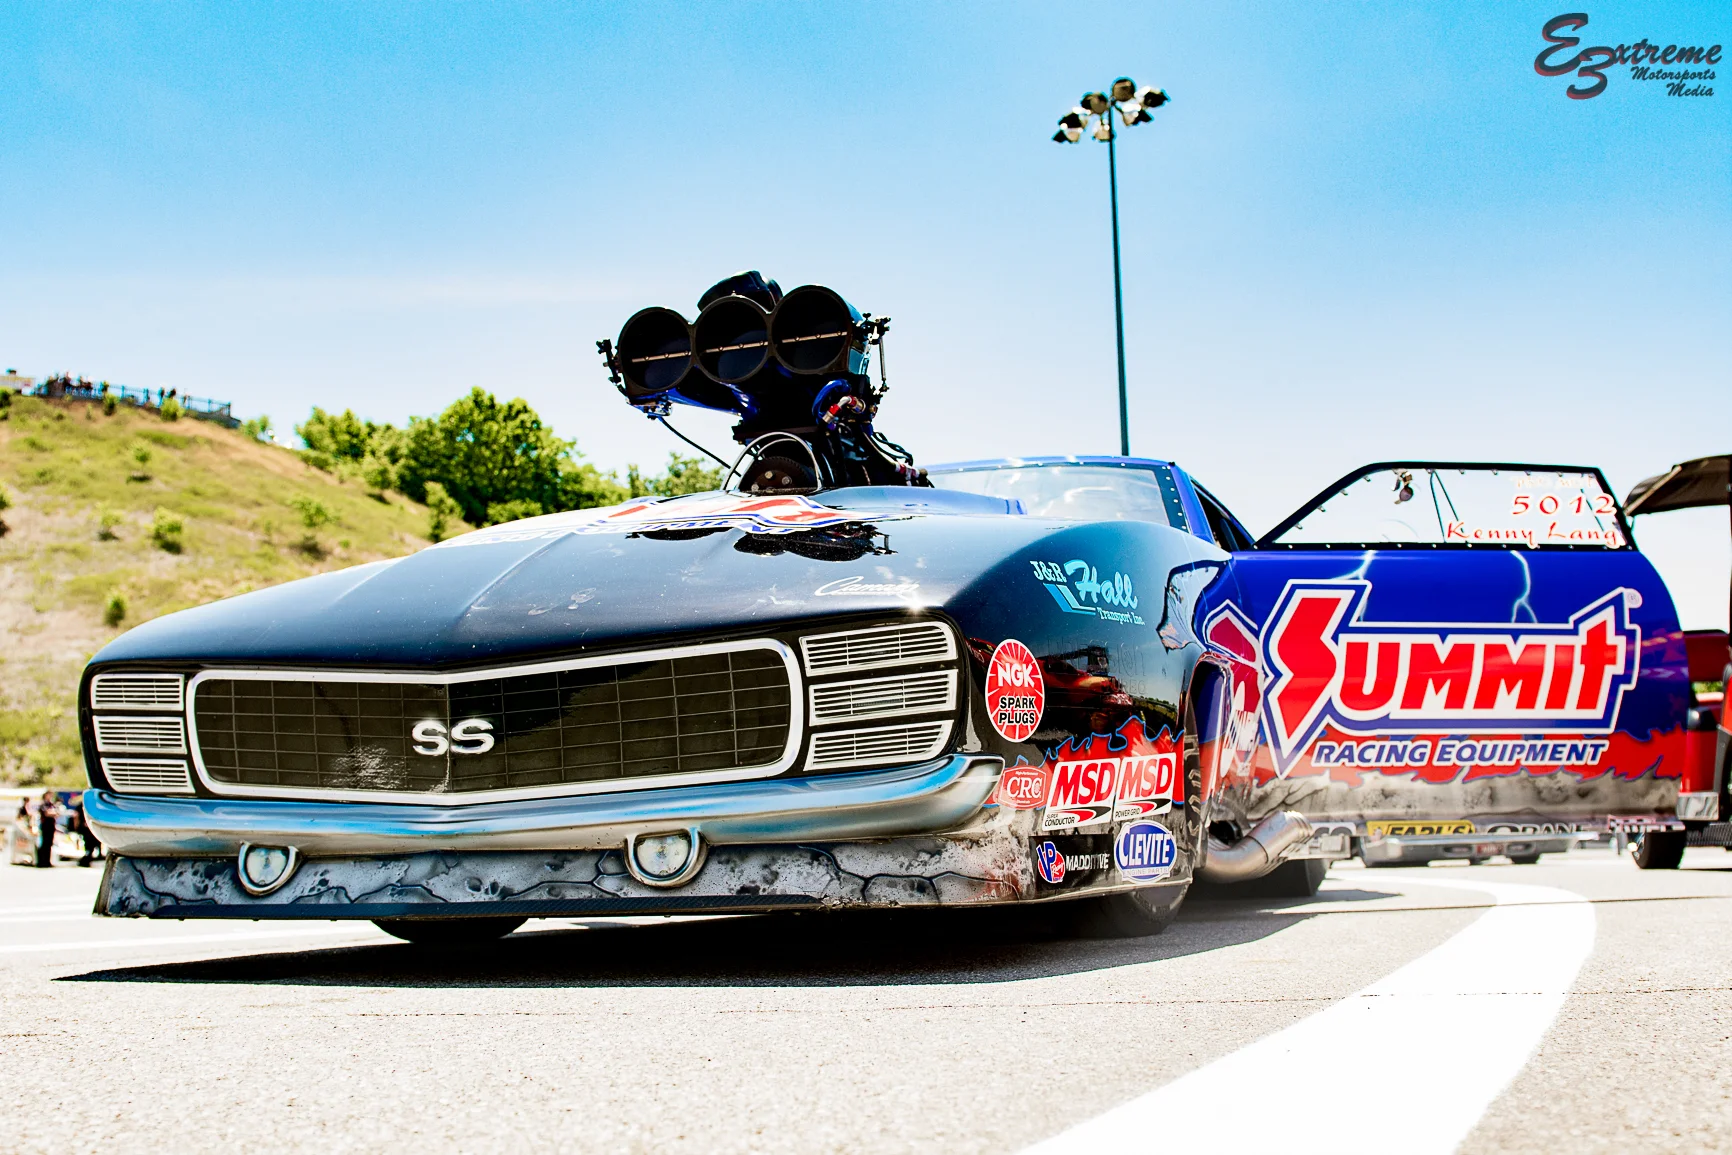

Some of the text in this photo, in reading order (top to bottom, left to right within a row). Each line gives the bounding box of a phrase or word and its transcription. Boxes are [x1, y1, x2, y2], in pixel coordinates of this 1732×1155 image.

[1512, 495, 1616, 515] 5012
[1446, 521, 1620, 547] Kenny Lang
[1029, 559, 1138, 610] J&R Hall
[1096, 607, 1133, 625] Transport
[996, 662, 1036, 688] NGK
[999, 696, 1035, 709] SPARK
[999, 712, 1035, 724] PLUGS
[411, 718, 495, 756] SS
[1314, 742, 1608, 765] RACING EQUIPMENT
[1006, 776, 1043, 799] CRC
[1050, 762, 1117, 808] MSD
[1118, 757, 1173, 800] MSD
[1044, 816, 1076, 827] CONDUCTOR
[1115, 809, 1130, 818] POWER
[1118, 822, 1172, 867] CLEVITE
[1036, 841, 1057, 883] VP
